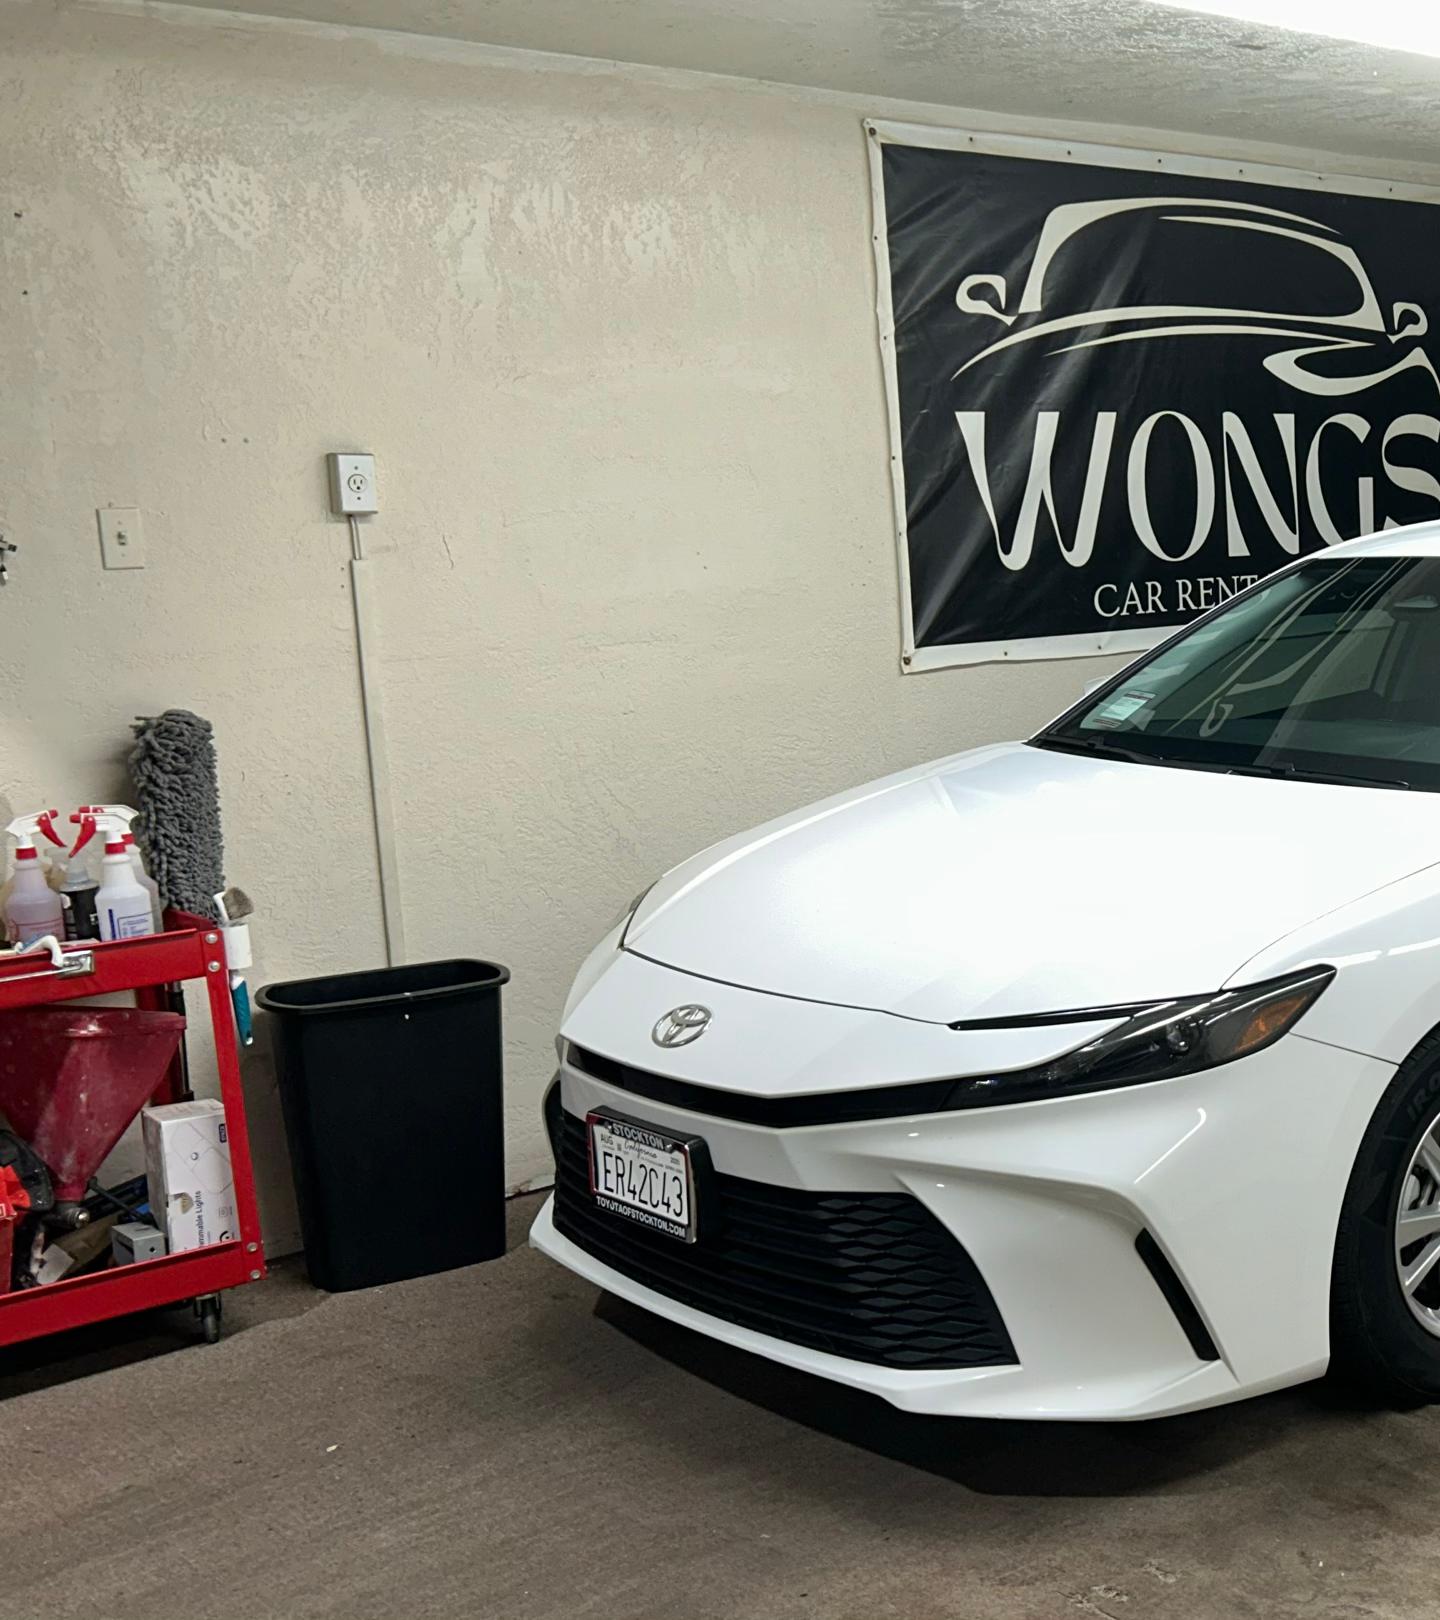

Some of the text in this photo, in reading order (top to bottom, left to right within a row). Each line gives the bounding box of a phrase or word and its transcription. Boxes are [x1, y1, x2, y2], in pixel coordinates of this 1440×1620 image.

[1094, 574, 1259, 618] CAR RENT
[613, 1123, 664, 1150] STOCKTON
[603, 1151, 683, 1217] ER42C43
